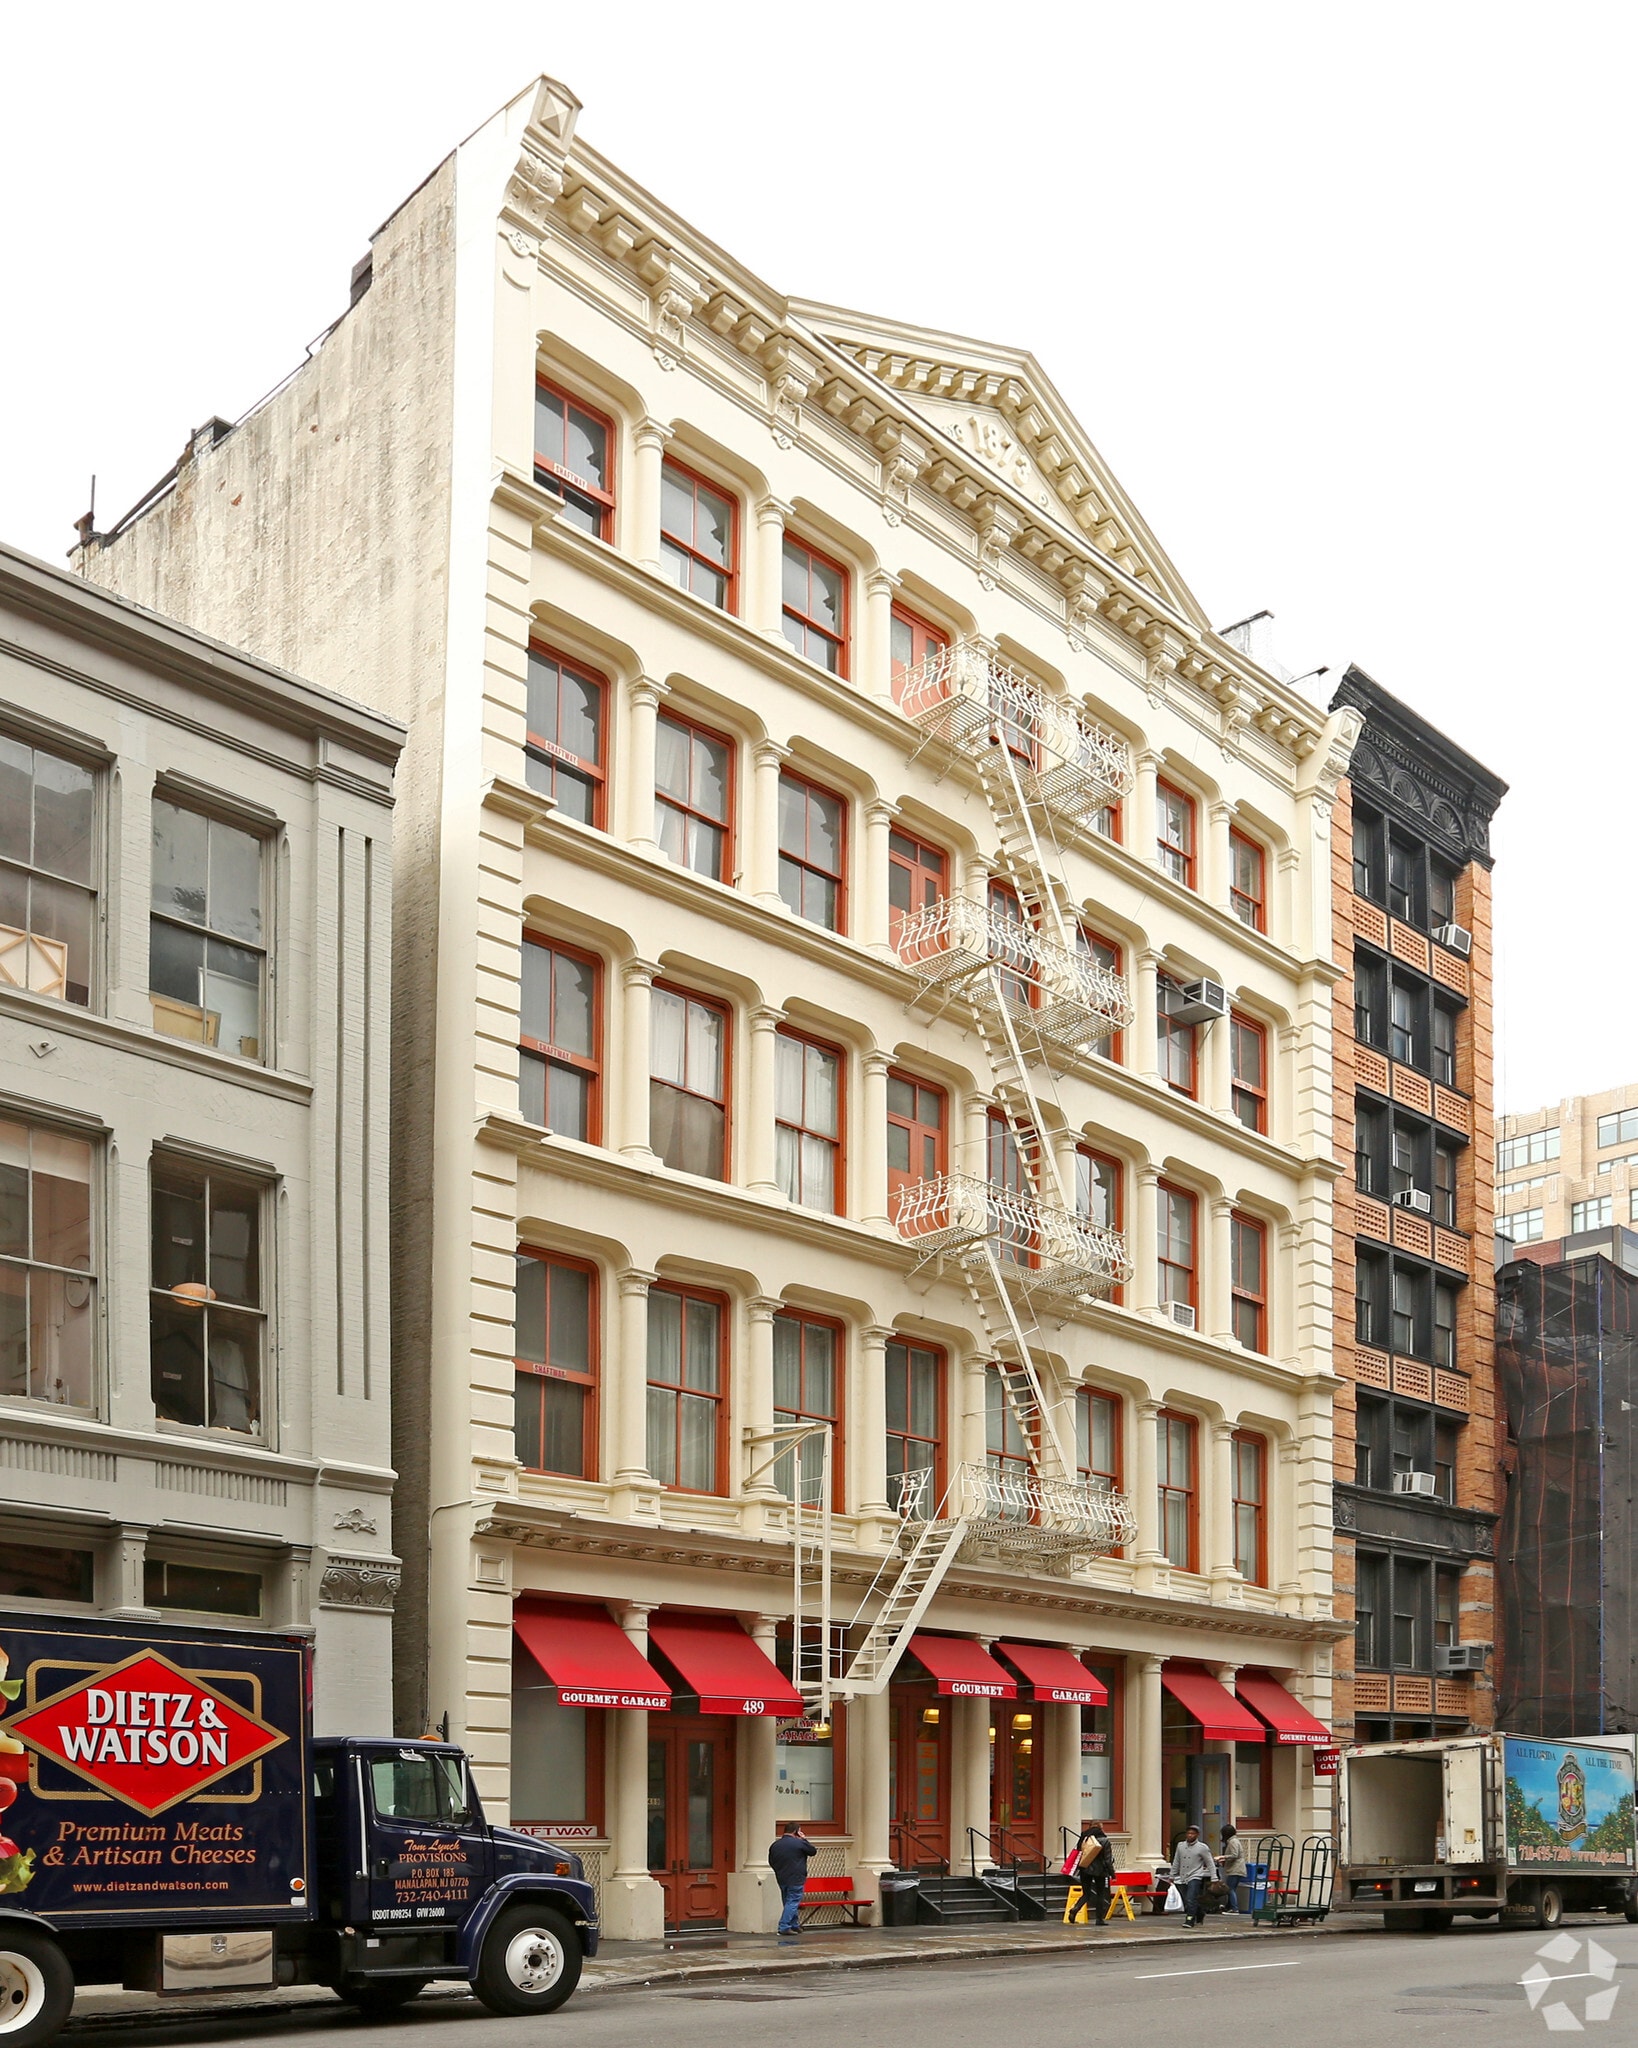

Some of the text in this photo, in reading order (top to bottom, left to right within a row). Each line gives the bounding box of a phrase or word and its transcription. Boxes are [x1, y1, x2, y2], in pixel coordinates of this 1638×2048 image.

[952, 1682, 1003, 1696] GOURMET
[562, 1692, 667, 1707] GOURMET GARAGE
[1052, 1690, 1091, 1702] GARAGE
[87, 1689, 228, 1729] DIETZ &
[742, 1700, 765, 1714] 489
[58, 1726, 227, 1766] WATSON
[1516, 1748, 1556, 1760] ALL FLORIDA
[1585, 1757, 1622, 1769] ALL THE TIME
[57, 1821, 243, 1842] Premium Meats
[512, 1823, 593, 1836] AFTWAY
[404, 1839, 460, 1853] Tom Lynch
[42, 1845, 256, 1866] & Artisan Cheeses
[399, 1852, 467, 1863] PROVISIONS
[411, 1867, 455, 1878] P.O. BOX 183
[73, 1880, 229, 1892] www.dietzandwatson.com
[450, 1877, 469, 1887] 07726
[396, 1889, 468, 1903] 732-740-4111
[372, 1910, 389, 1920] USDOT
[416, 1907, 429, 1918] GVW
[429, 1907, 445, 1917] 26000
[1503, 1904, 1536, 1913] milea
